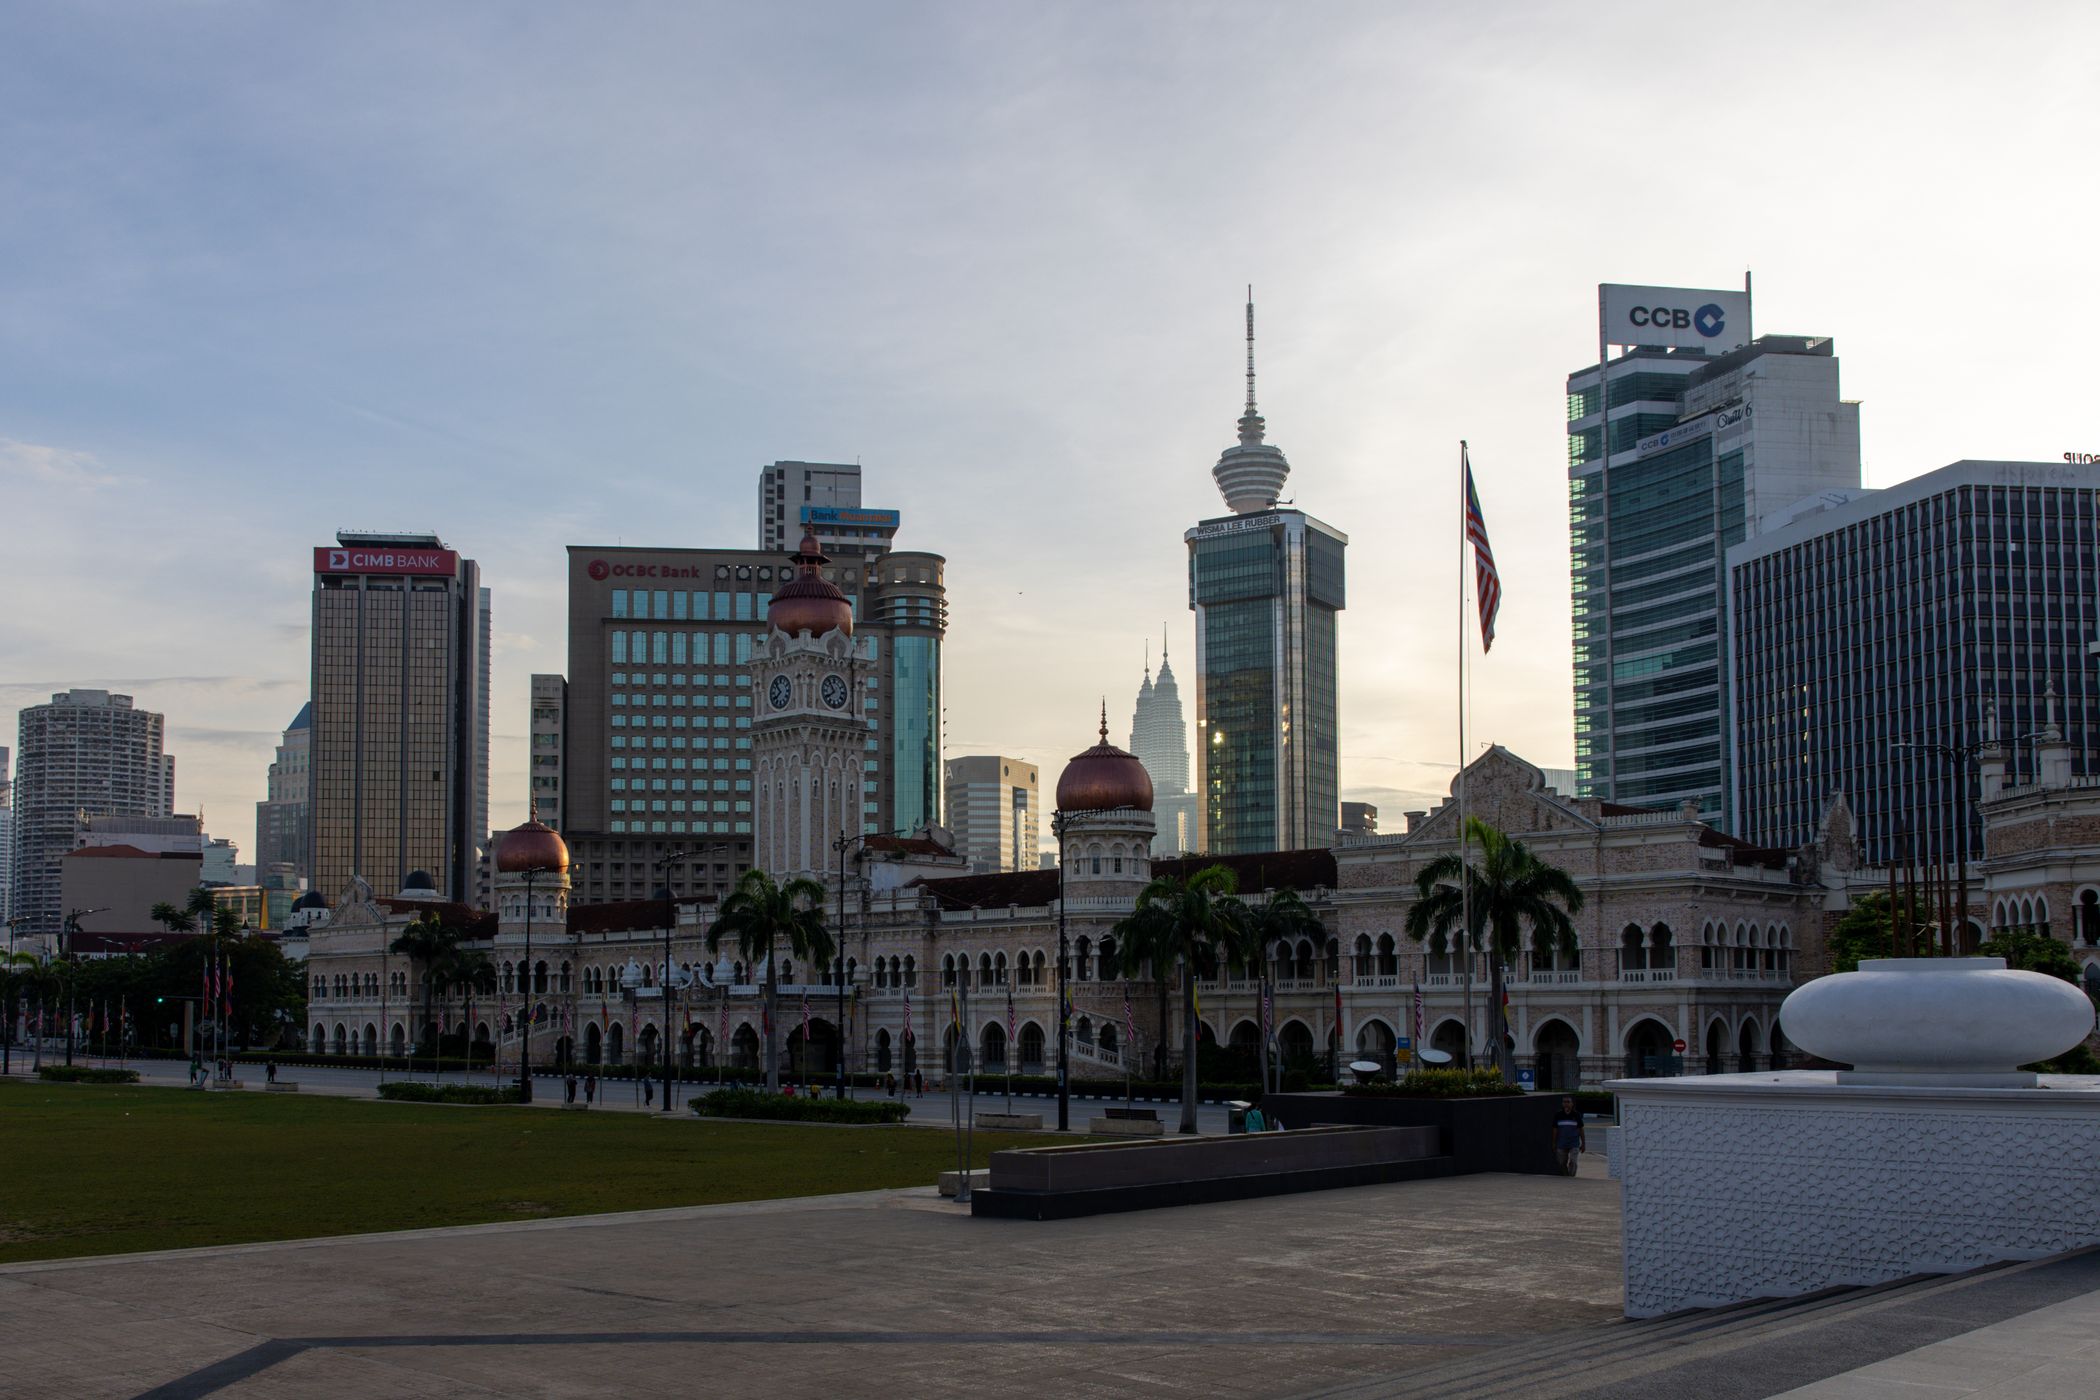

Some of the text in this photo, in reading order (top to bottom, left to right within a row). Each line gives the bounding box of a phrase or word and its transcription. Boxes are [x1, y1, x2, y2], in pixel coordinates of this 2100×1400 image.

[1629, 305, 1691, 329] CCB
[1745, 401, 1753, 417] 6
[1641, 439, 1659, 450] CCB
[811, 510, 838, 521] Bank
[1197, 515, 1281, 536] WISMA LEE RUBBER
[352, 553, 440, 568] CIMB BANK
[612, 564, 700, 578] OCBC Bank
